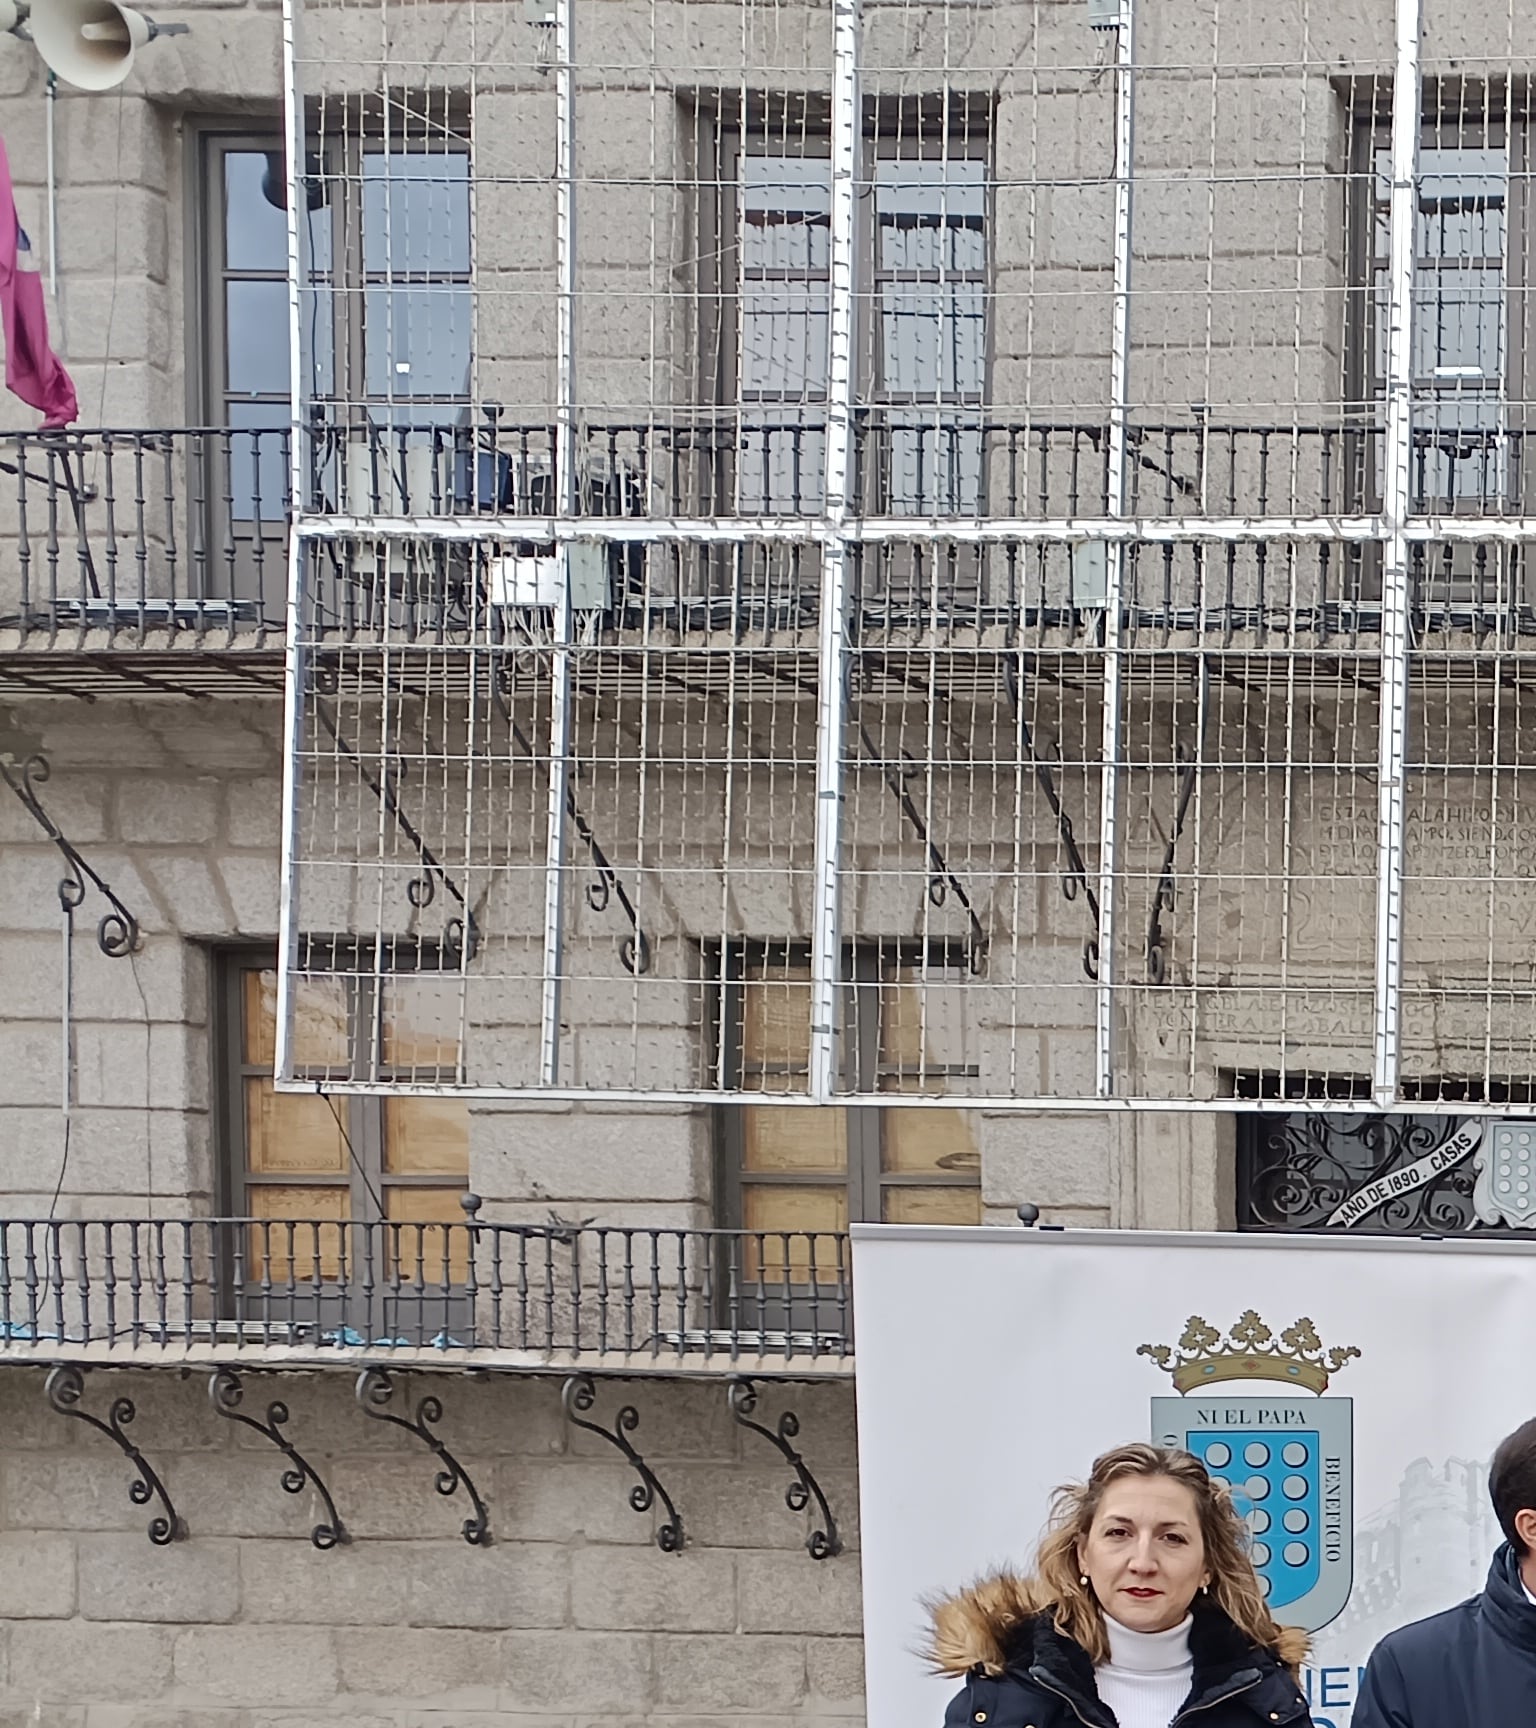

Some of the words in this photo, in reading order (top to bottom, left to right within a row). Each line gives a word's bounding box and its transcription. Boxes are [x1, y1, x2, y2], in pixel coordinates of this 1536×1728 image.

[1367, 1183, 1389, 1202] DE
[1431, 1133, 1471, 1171] CASAS
[1197, 1410, 1217, 1425] NI
[1225, 1410, 1252, 1424] EL
[1258, 1409, 1307, 1425] PAPA
[1325, 1457, 1341, 1563] BENEFICIO
